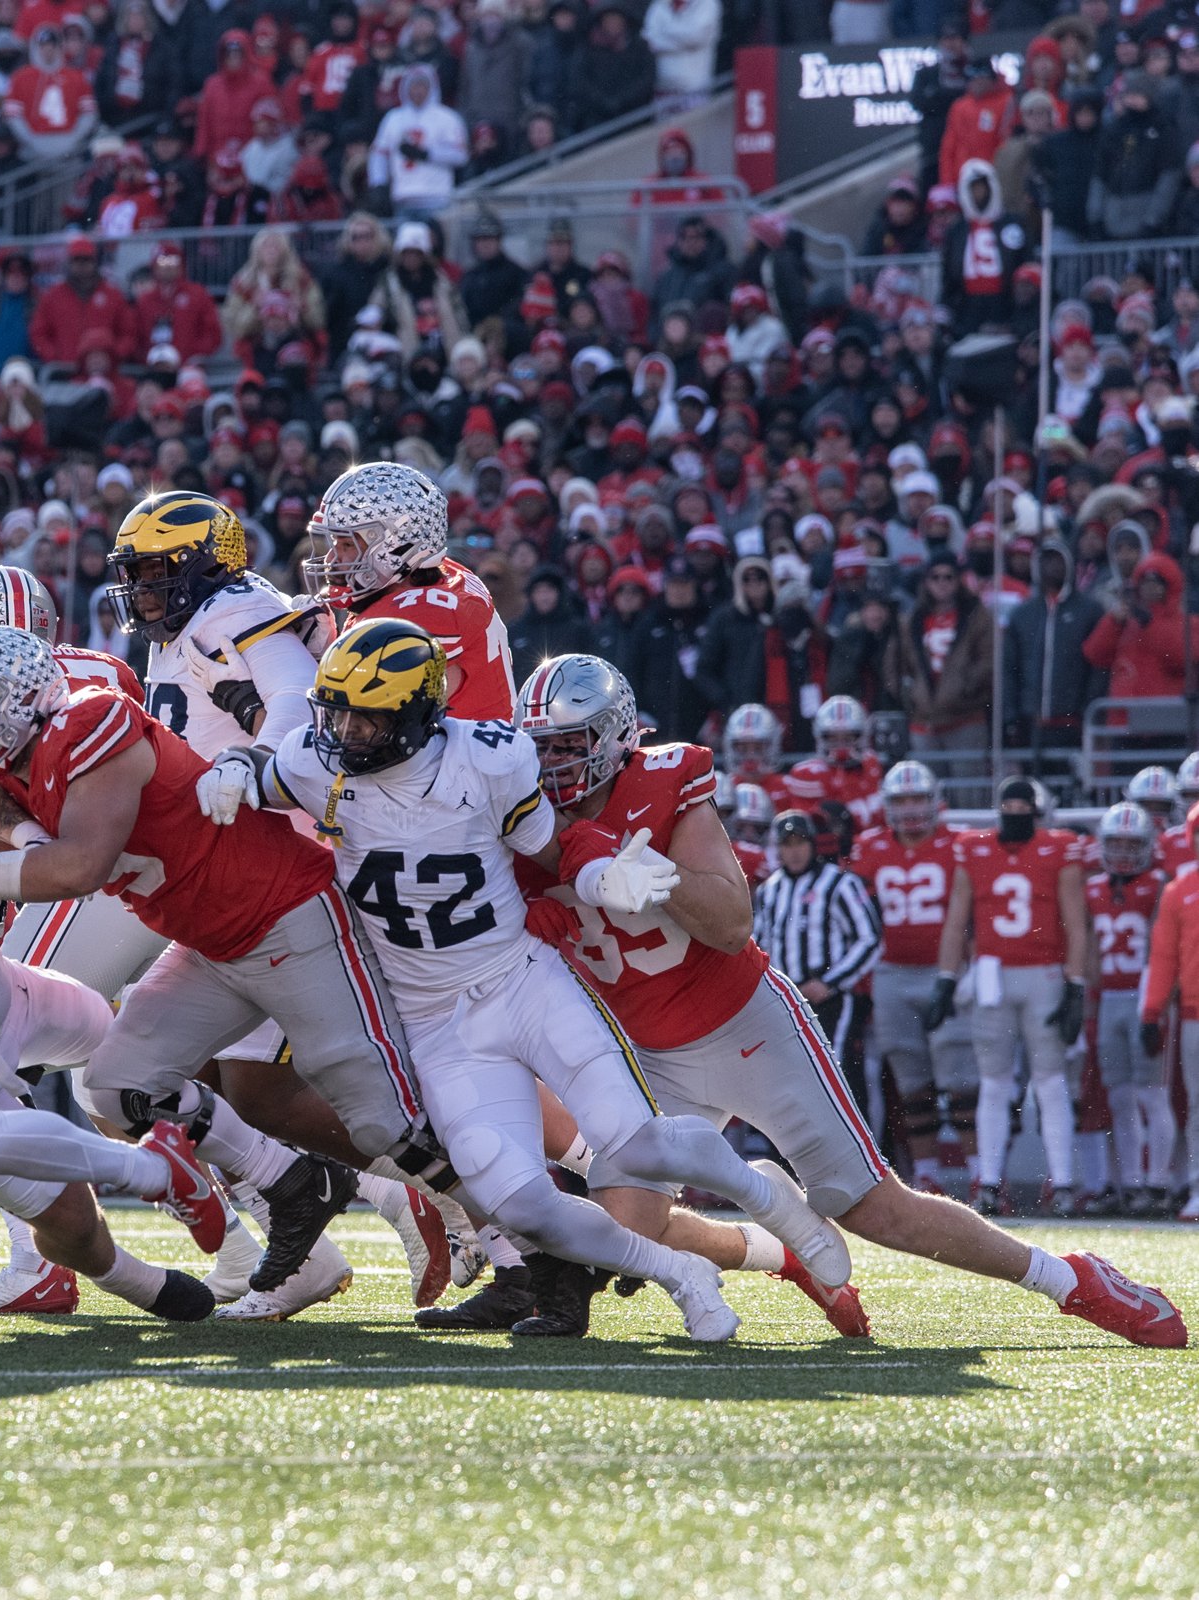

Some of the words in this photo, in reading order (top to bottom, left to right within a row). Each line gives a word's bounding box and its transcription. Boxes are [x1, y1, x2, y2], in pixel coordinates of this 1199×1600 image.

[39, 85, 67, 127] 4
[392, 588, 459, 610] 70
[472, 719, 517, 749] 42
[347, 851, 497, 949] 42
[875, 862, 946, 926] 62
[992, 872, 1032, 938] 3
[1093, 911, 1148, 974] 23
